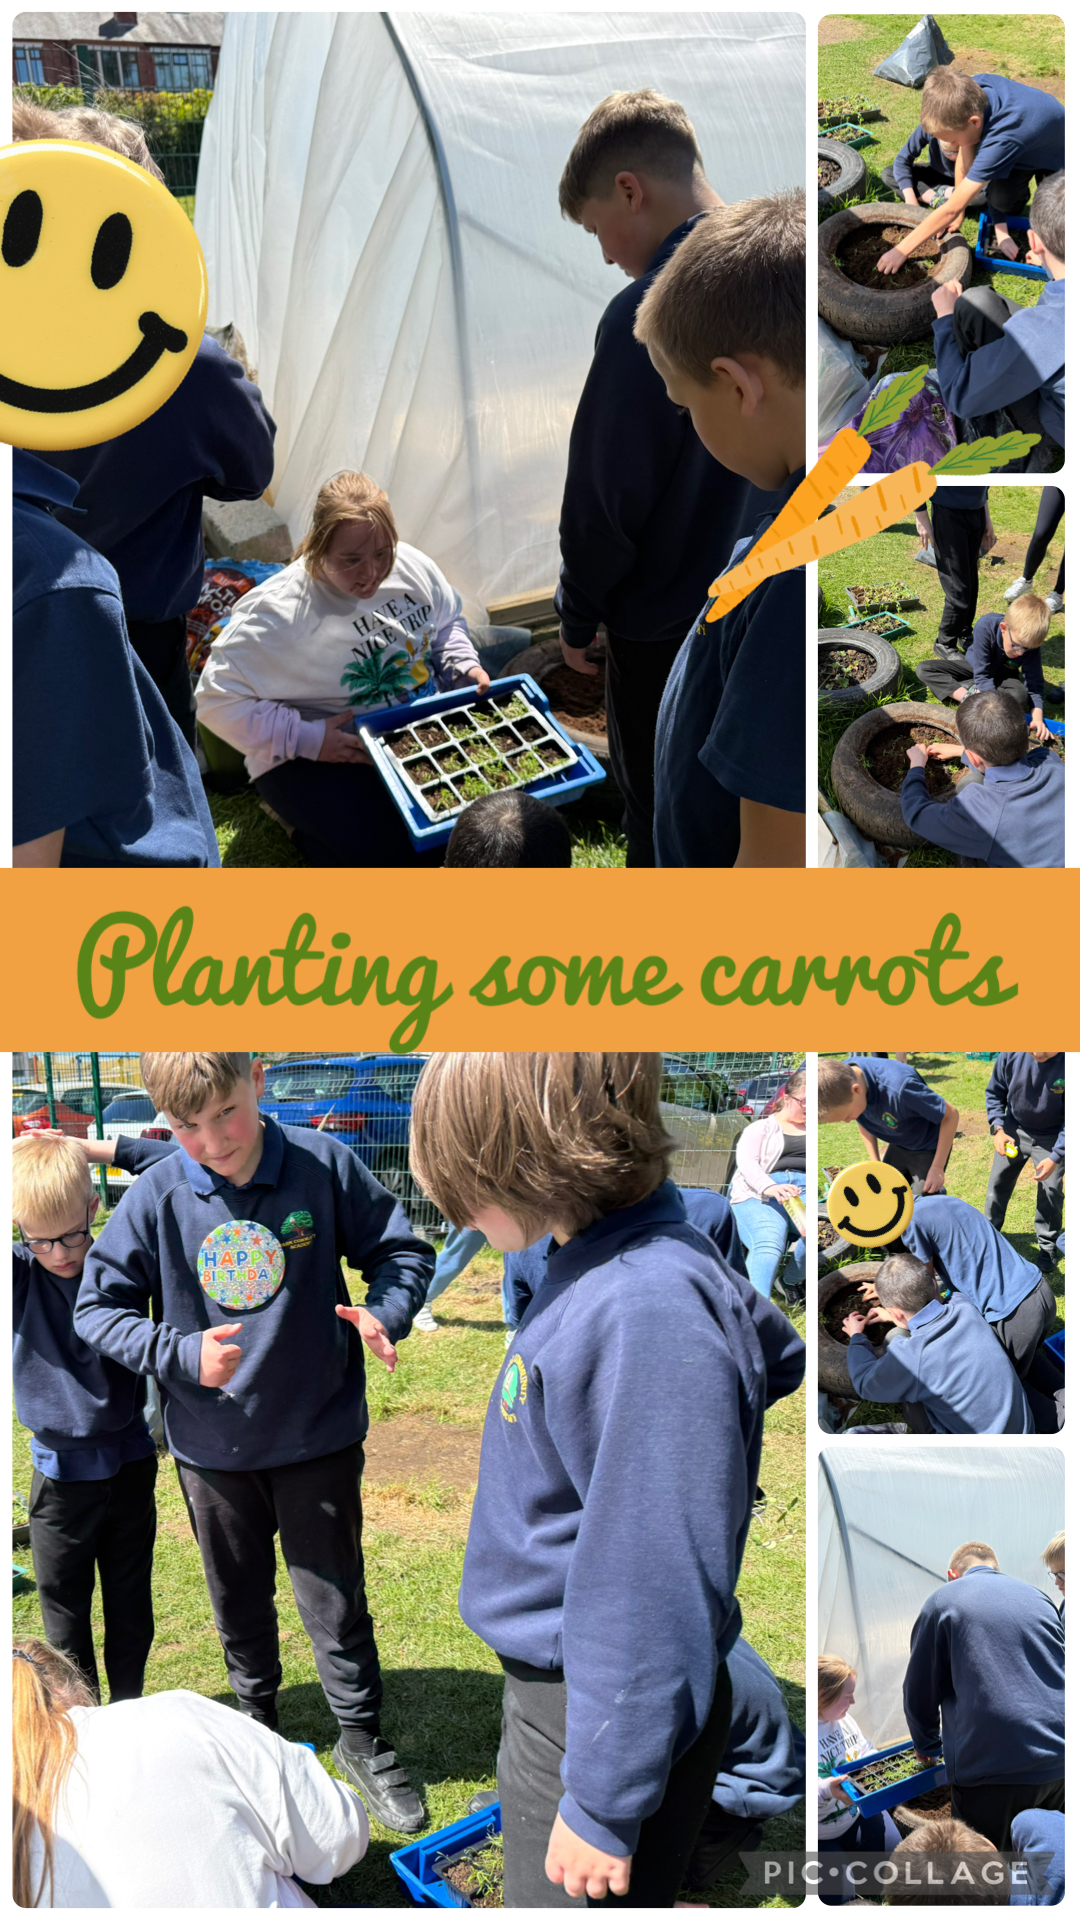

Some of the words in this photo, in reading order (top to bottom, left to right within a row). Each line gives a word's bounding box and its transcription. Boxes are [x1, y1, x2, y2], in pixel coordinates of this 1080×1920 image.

[352, 599, 402, 637] HAVE
[403, 593, 417, 610] A
[351, 626, 397, 664] NICE
[397, 604, 431, 637] TRIP
[204, 1249, 277, 1267] HAPPY
[203, 1268, 279, 1282] BIRTHDAY
[819, 1730, 843, 1750] HAVE
[842, 1727, 849, 1737] A
[820, 1745, 842, 1765] NICE
[840, 1734, 858, 1751] TRIP
